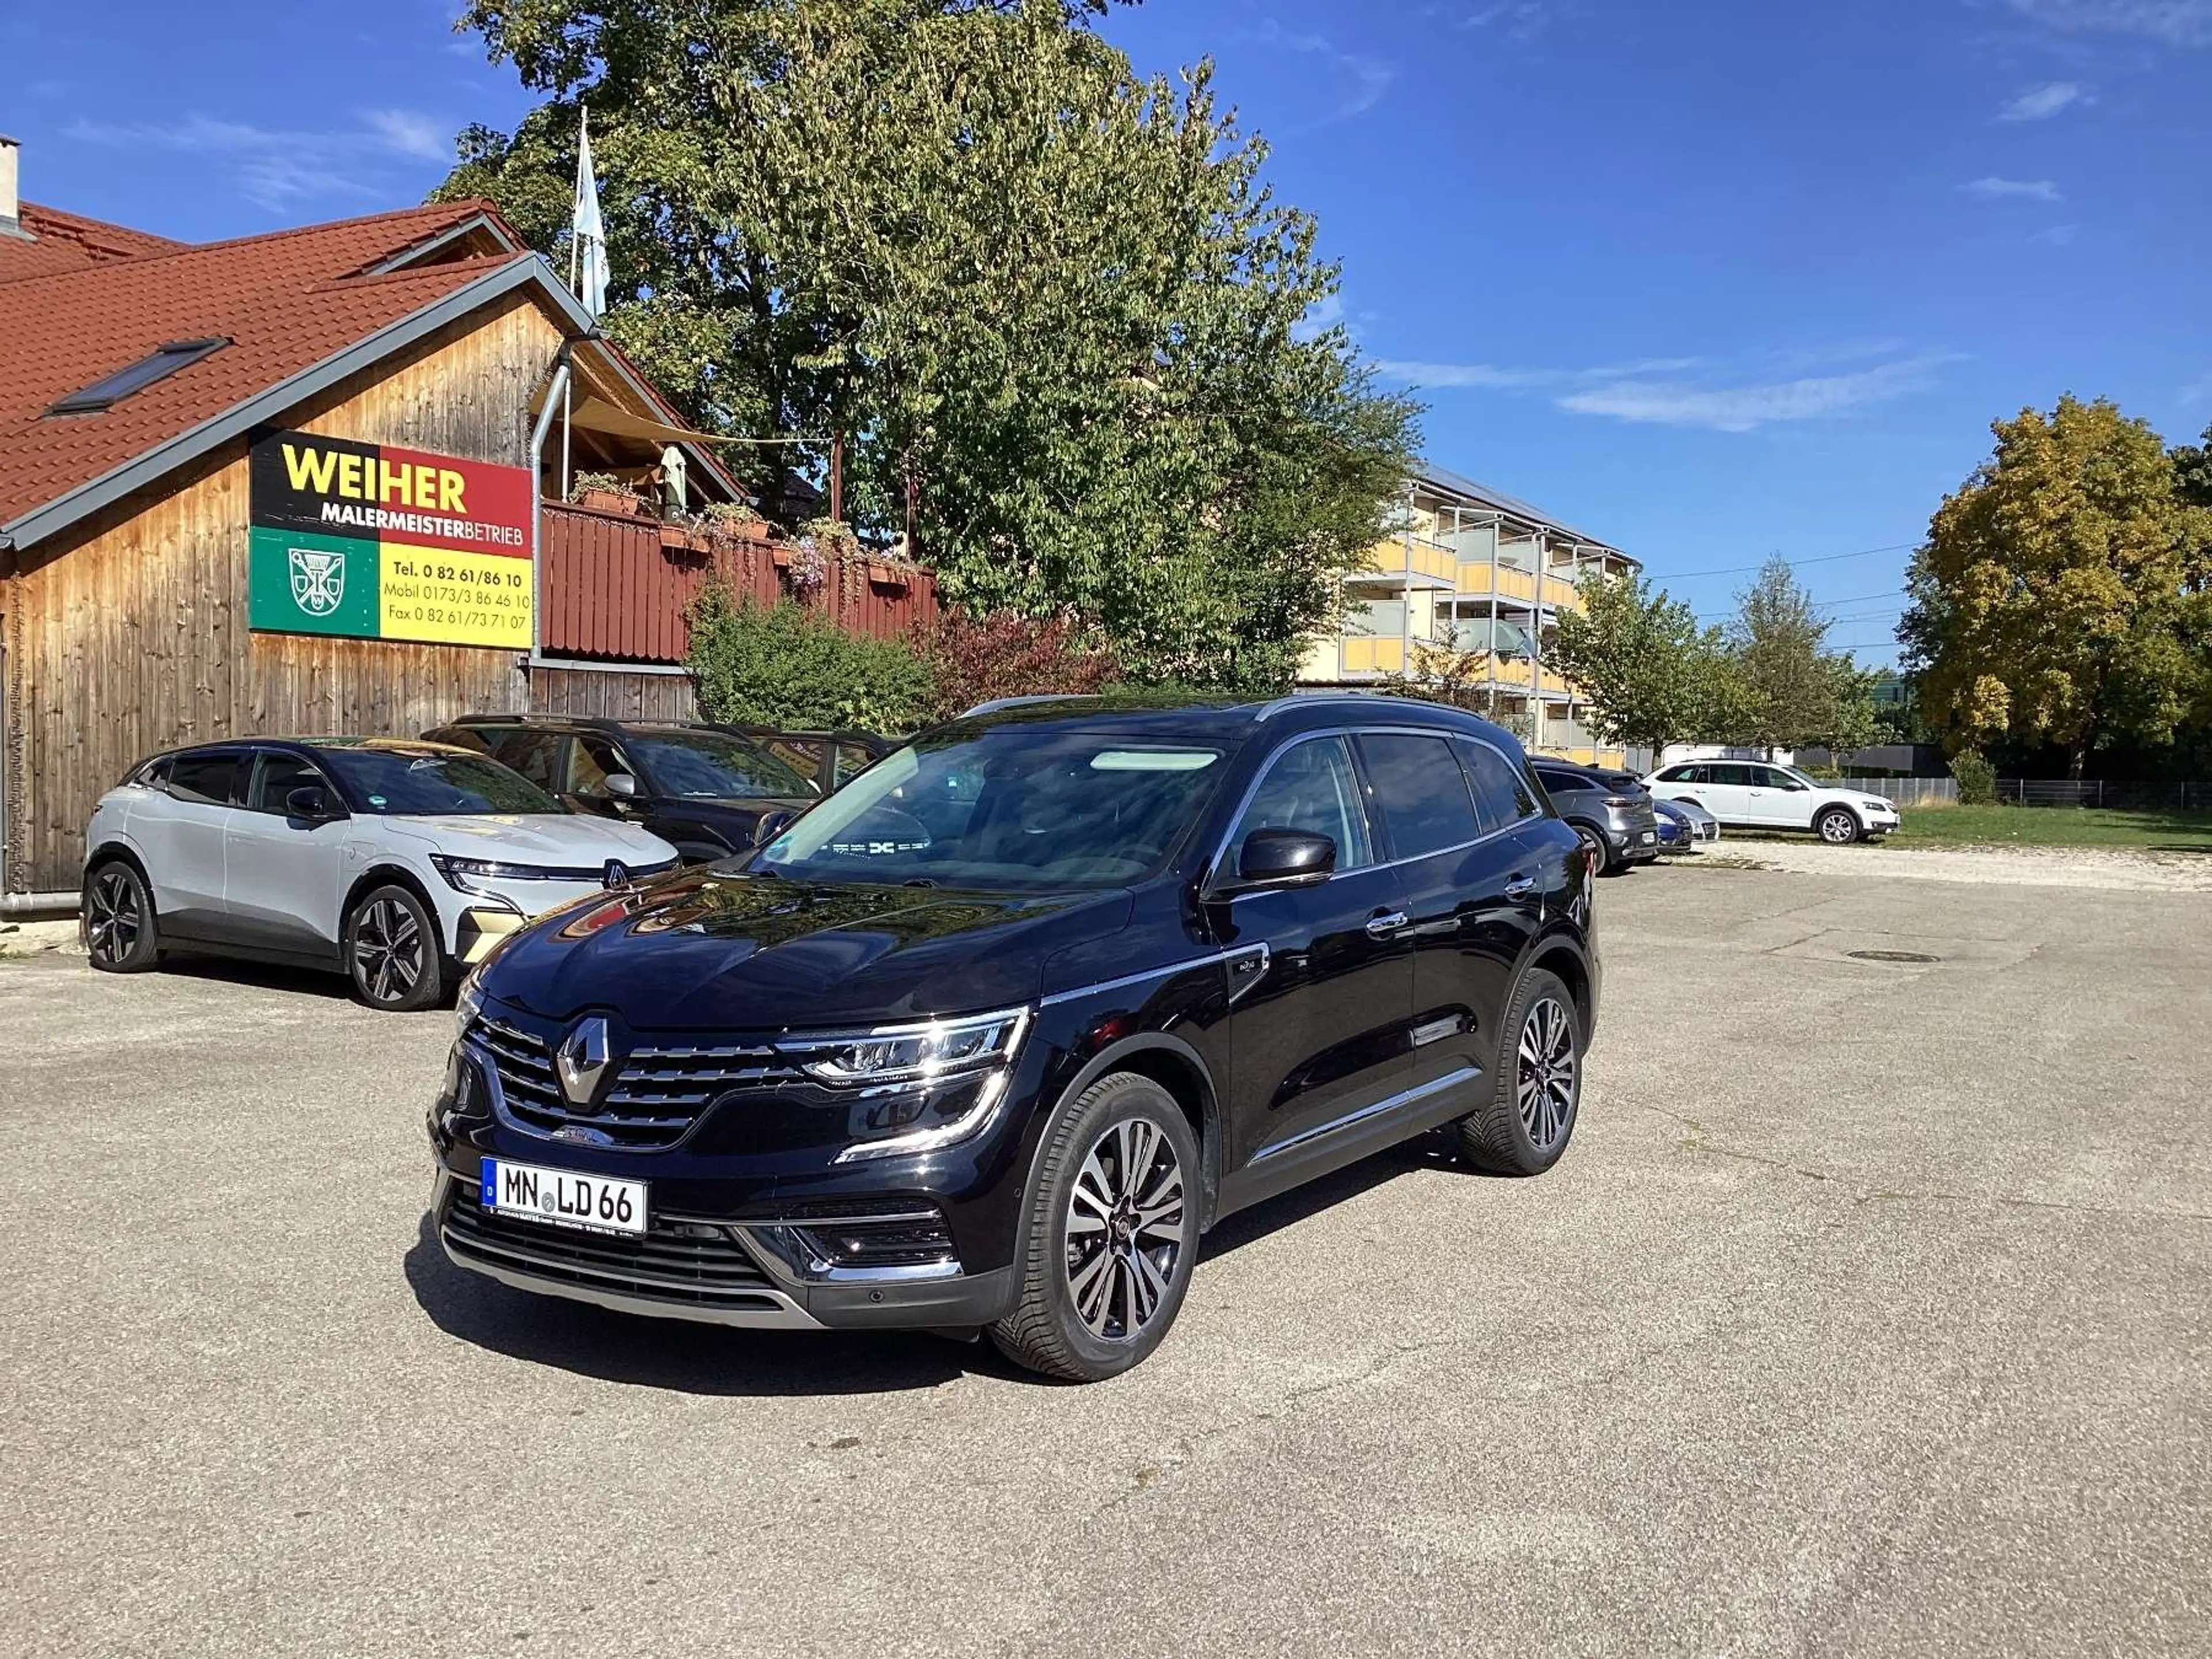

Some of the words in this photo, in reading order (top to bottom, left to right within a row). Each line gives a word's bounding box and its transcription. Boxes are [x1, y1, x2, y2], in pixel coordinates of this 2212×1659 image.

[282, 444, 468, 513] WEIHER
[321, 502, 524, 546] MALERMEISTERBETRIEB
[393, 562, 418, 577] Tel.
[423, 565, 432, 578] 0
[437, 566, 454, 580] 82
[460, 569, 501, 585] 61/86
[507, 574, 522, 588] 10
[384, 582, 419, 598] Mobil
[423, 586, 471, 604] 0173/3
[476, 591, 491, 605] 86
[517, 595, 530, 609] 10
[389, 605, 411, 620] Fax
[415, 607, 423, 620] 0
[427, 608, 444, 622] 82
[448, 611, 487, 627] 61/73
[491, 614, 505, 627] 71
[510, 615, 525, 628] 07
[506, 1168, 537, 1207] MN
[558, 1177, 591, 1216] LD
[599, 1184, 632, 1222] 66
